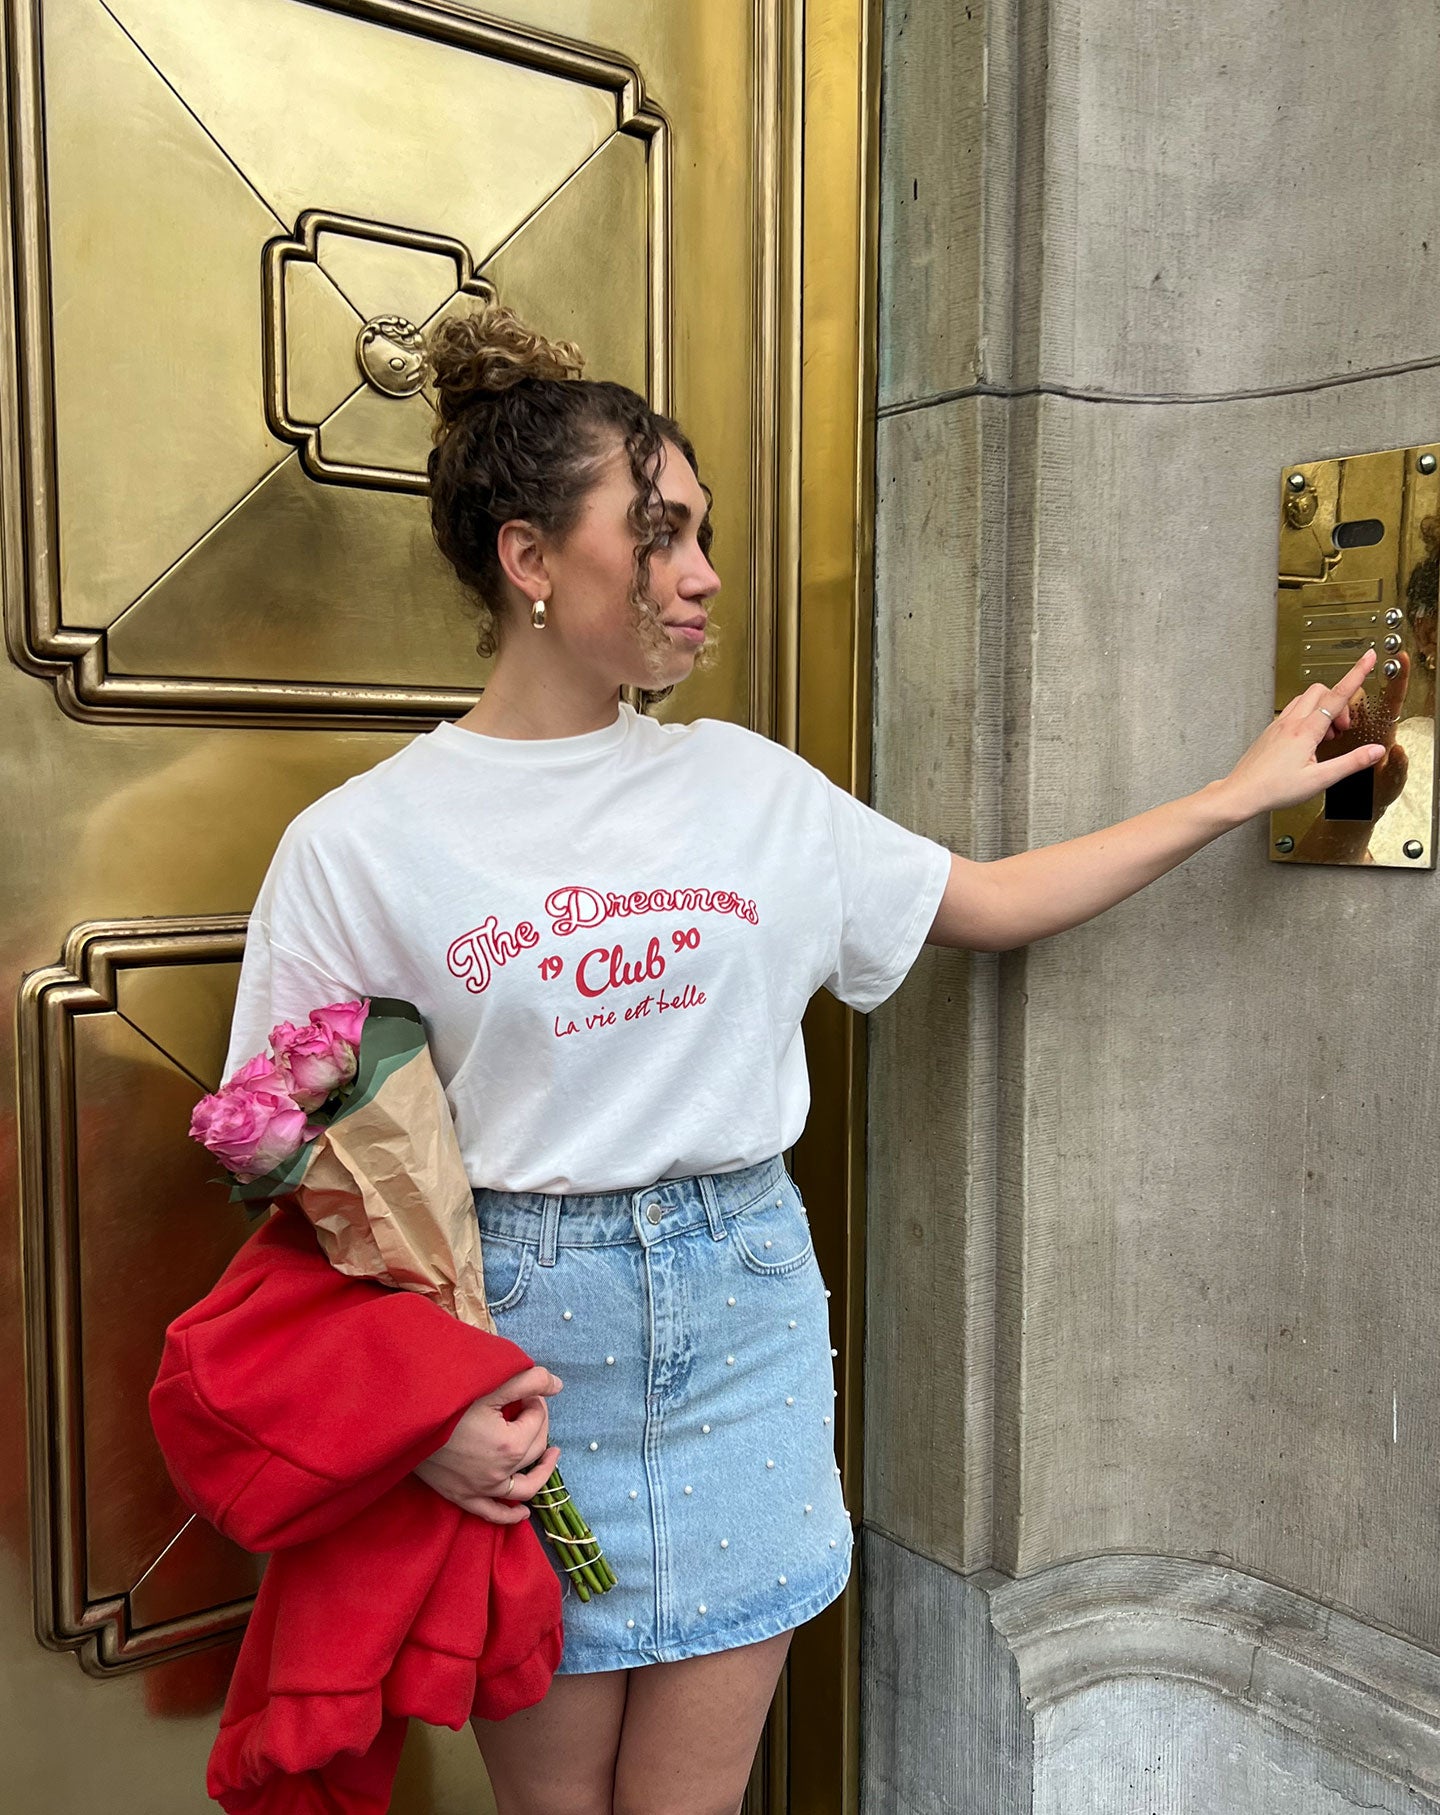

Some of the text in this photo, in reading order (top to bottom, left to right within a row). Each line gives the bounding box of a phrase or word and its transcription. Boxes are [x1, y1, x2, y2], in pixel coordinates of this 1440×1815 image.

[446, 885, 760, 995] The Dreamers
[537, 927, 701, 999] 19 Club 90
[554, 984, 708, 1038] La vie est belle
